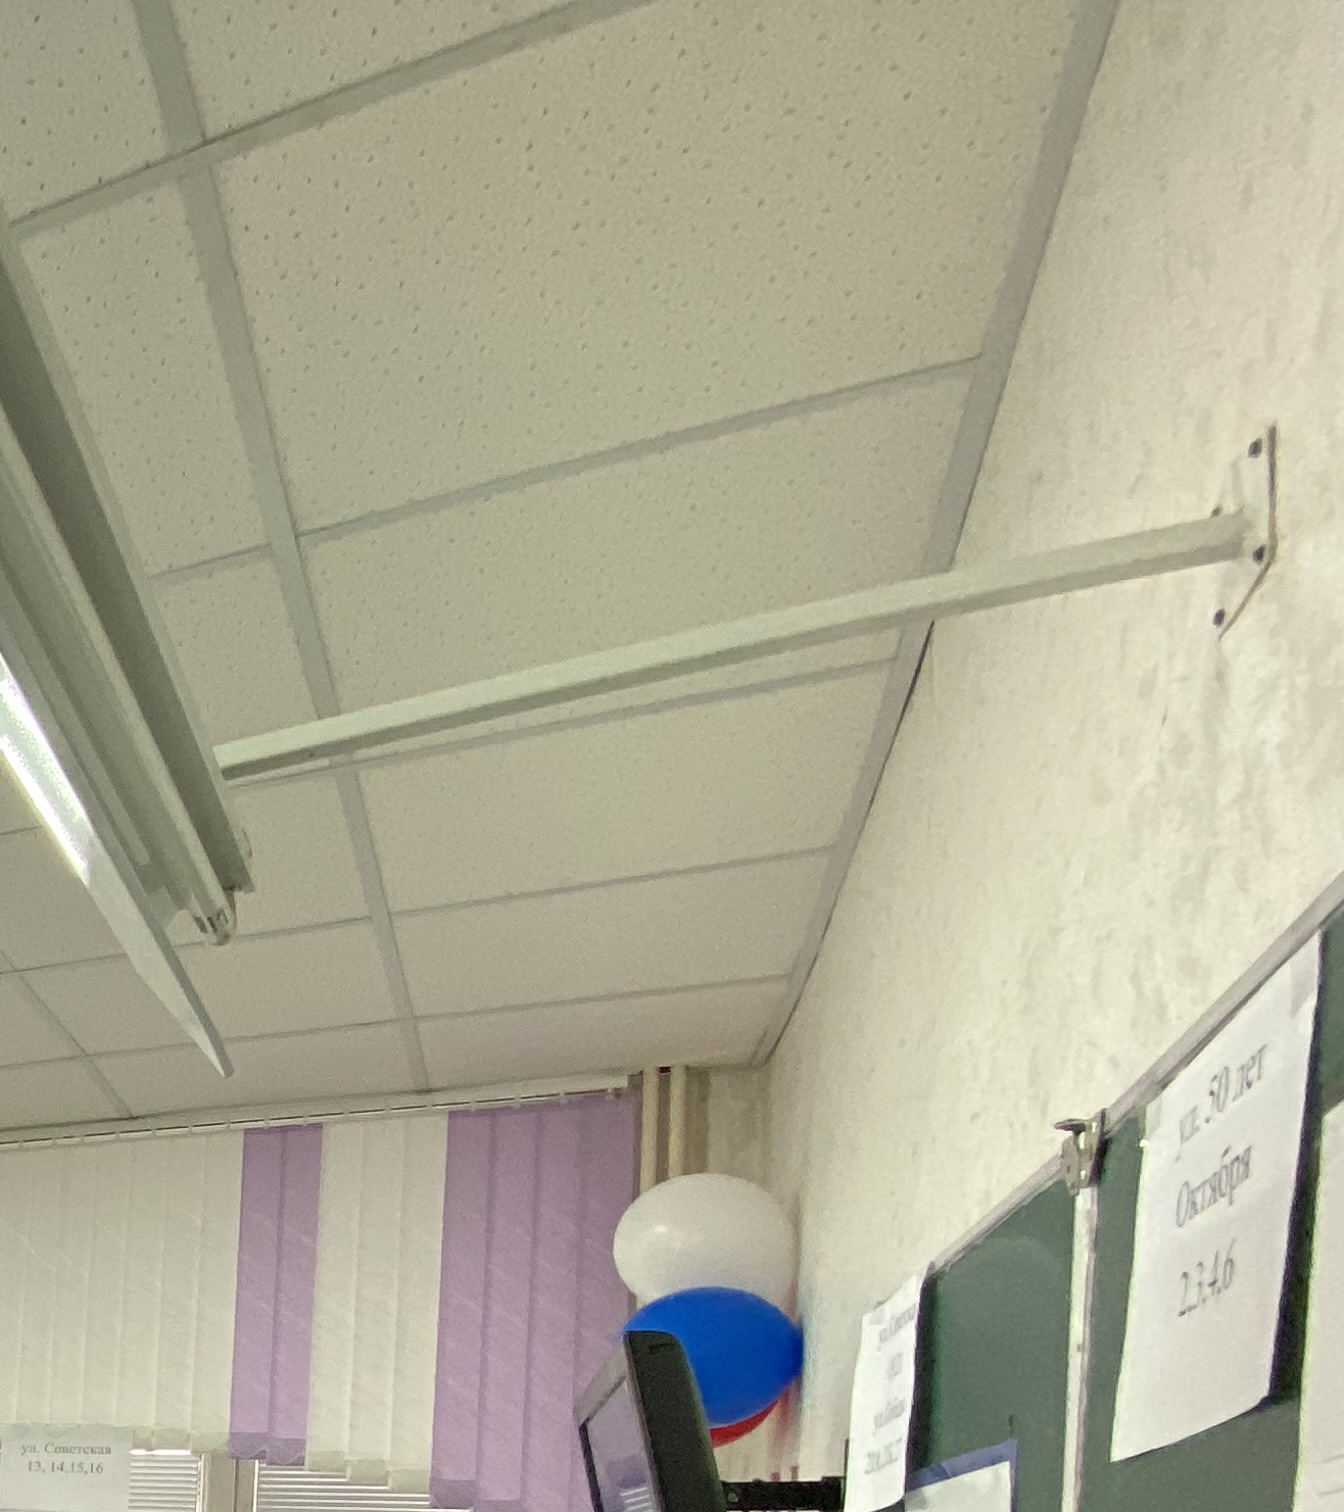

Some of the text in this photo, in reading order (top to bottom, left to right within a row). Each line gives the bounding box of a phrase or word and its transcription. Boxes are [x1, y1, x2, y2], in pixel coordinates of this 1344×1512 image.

[1204, 1065, 1230, 1125] 50
[1231, 1043, 1269, 1104] лет
[1175, 1144, 1252, 1229] Октября
[20, 1442, 112, 1456] ул. Советская
